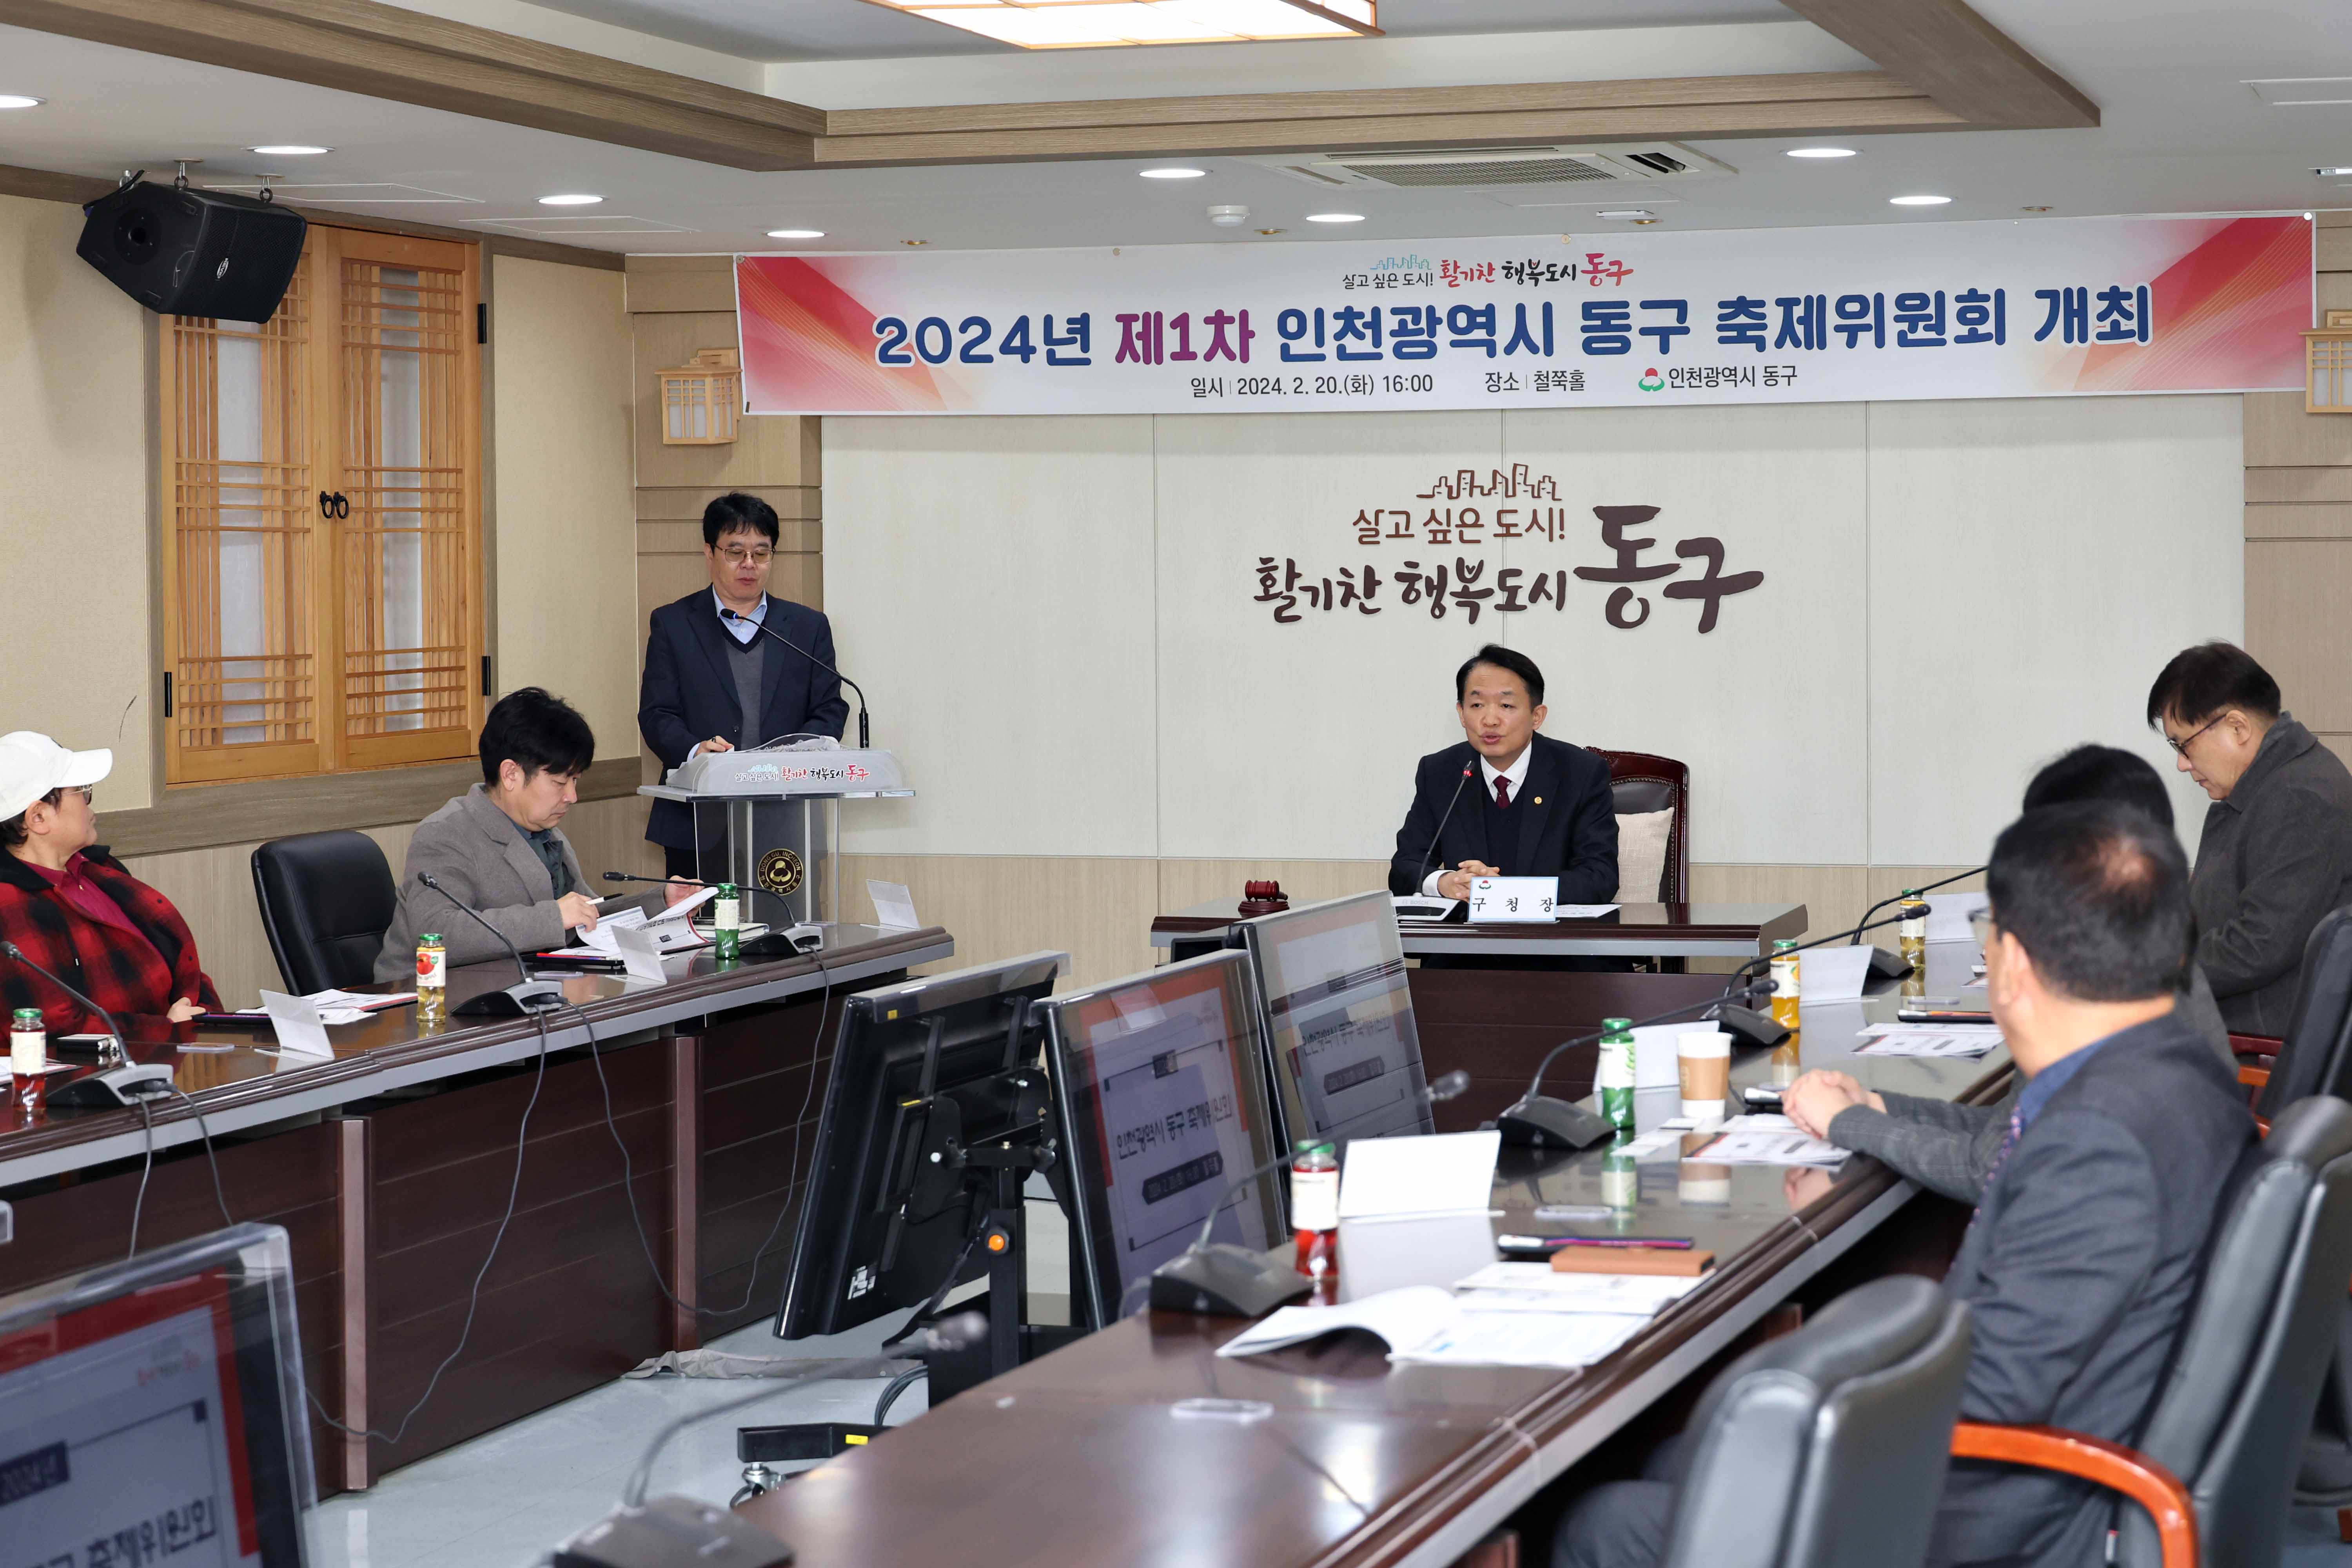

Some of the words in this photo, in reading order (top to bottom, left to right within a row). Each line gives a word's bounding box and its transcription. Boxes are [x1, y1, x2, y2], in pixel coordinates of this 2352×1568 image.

[1343, 274, 1369, 289] 살고
[1373, 273, 1399, 289] 싶은
[1403, 272, 1433, 287] 도시!
[1439, 260, 1495, 288] 활기찬
[1501, 259, 1576, 287] 행복도시
[1581, 253, 1633, 287] 동구
[875, 312, 1091, 366] 2024년
[1115, 309, 1255, 365] 제1차
[1278, 301, 1553, 362] 인천광역시
[1580, 299, 1690, 355] 동구
[1716, 288, 2005, 352] 축제위원회
[2034, 285, 2149, 344] 개최
[1191, 377, 1223, 397] 일시
[1238, 377, 1287, 395] 2024.
[1293, 377, 1308, 394] 2.
[1383, 374, 1432, 392] 16:00
[1485, 372, 1519, 392] 장소
[1534, 370, 1585, 392] 철쭉홀
[1669, 366, 1755, 388] 인천광역시
[1762, 366, 1797, 387] 동구
[1353, 509, 1415, 545] 살고
[1423, 508, 1485, 544] 싶은
[1493, 508, 1565, 544] 도시!
[1254, 557, 1382, 623] 활기찬
[1394, 557, 1566, 624] 행복도시
[1573, 505, 1764, 634] 동구
[782, 767, 807, 781] 활기찬
[810, 768, 843, 780] 행복도시
[846, 765, 869, 780] 동구
[760, 855, 771, 871] DONG
[782, 851, 801, 871] INCHEON
